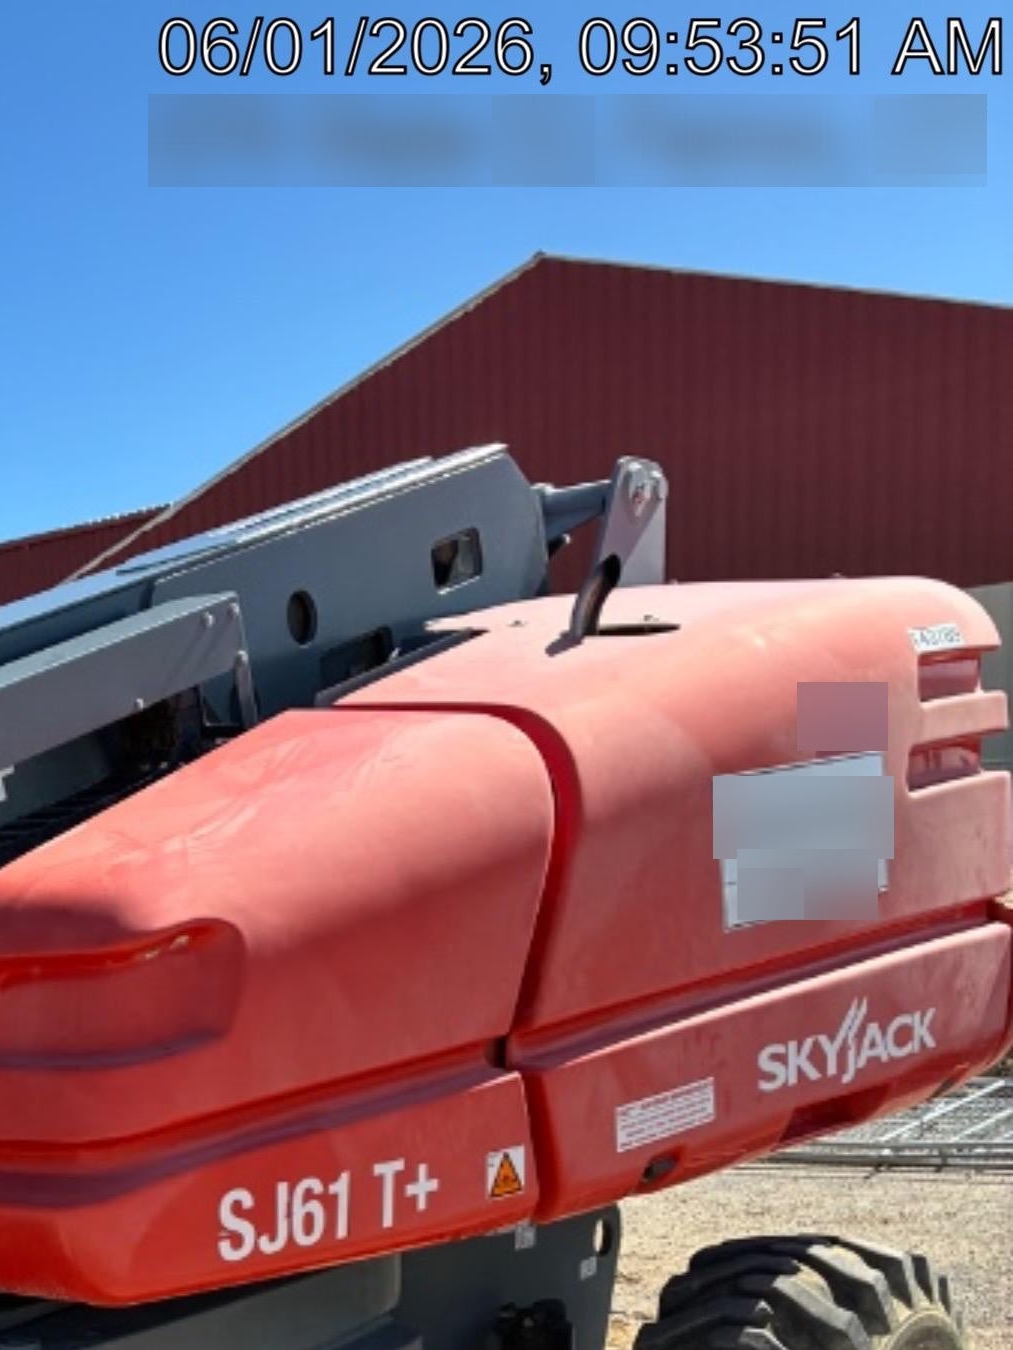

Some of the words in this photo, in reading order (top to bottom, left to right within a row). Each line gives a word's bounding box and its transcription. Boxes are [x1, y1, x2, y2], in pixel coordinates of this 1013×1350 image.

[756, 997, 937, 1092] SKYJACK
[217, 1170, 351, 1262] SJ61
[373, 1158, 440, 1228] T+
